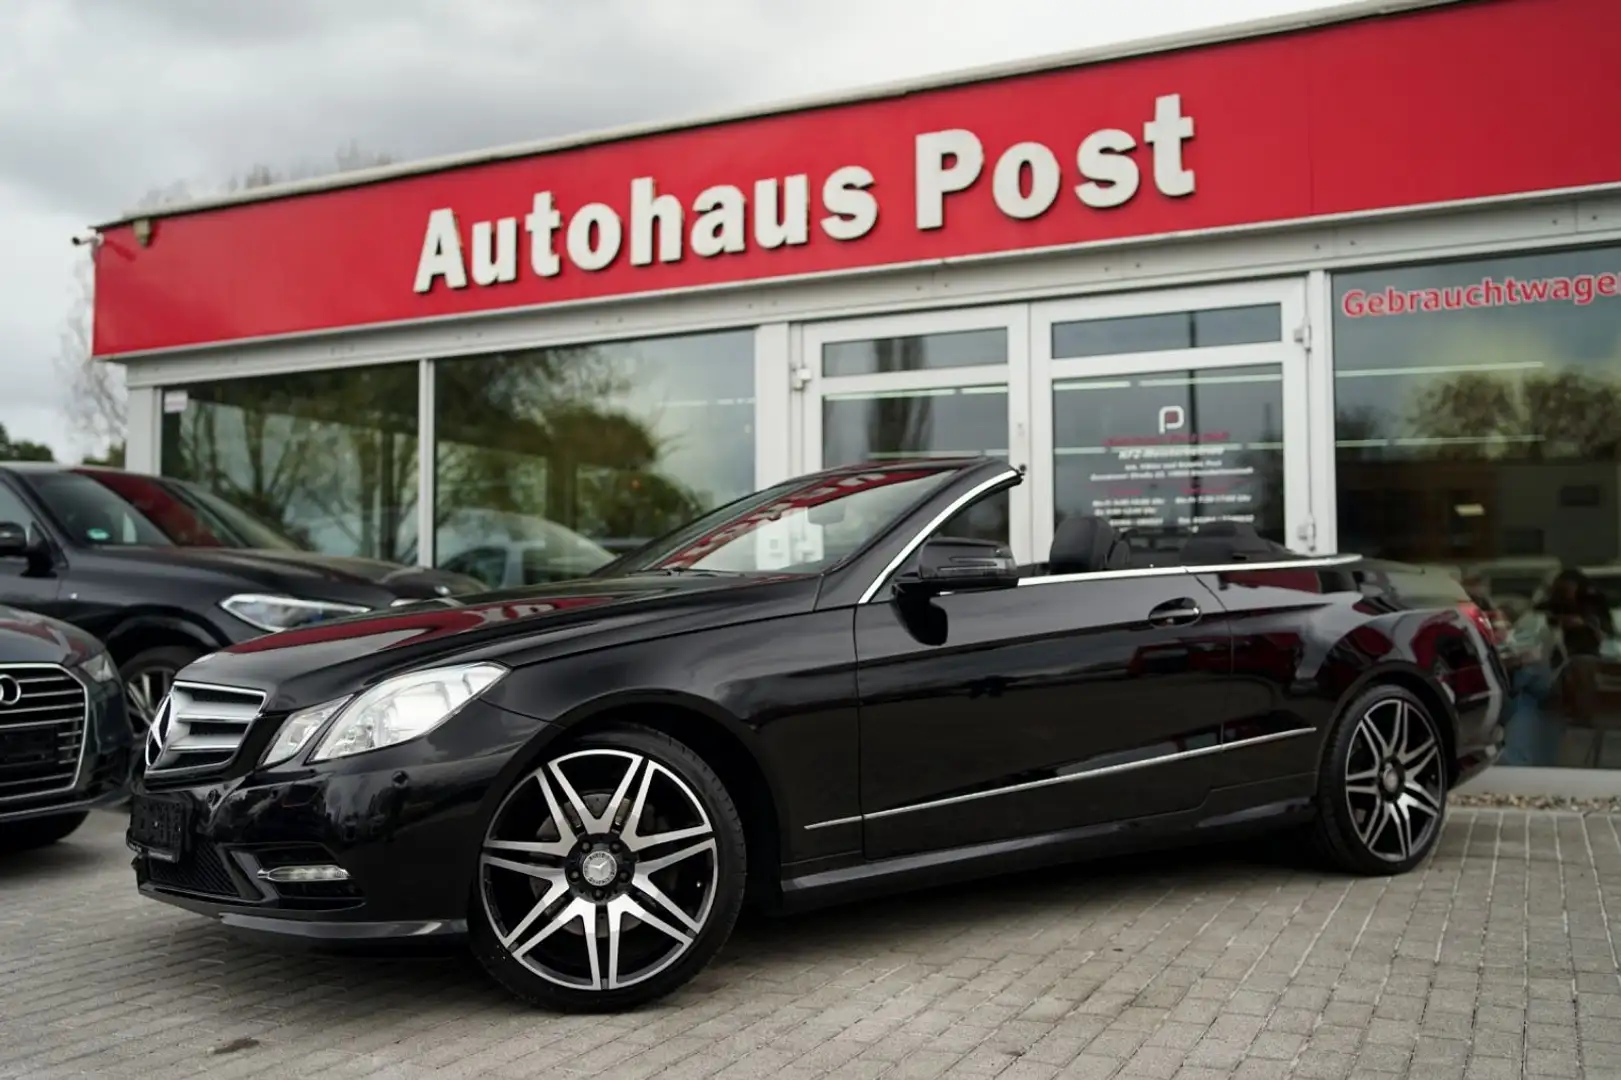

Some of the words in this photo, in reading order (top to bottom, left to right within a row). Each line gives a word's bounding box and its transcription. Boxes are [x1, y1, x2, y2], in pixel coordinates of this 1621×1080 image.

[413, 165, 879, 294] Autohaus
[914, 93, 1197, 231] Post
[1340, 271, 1621, 319] Gebrauchtwage
